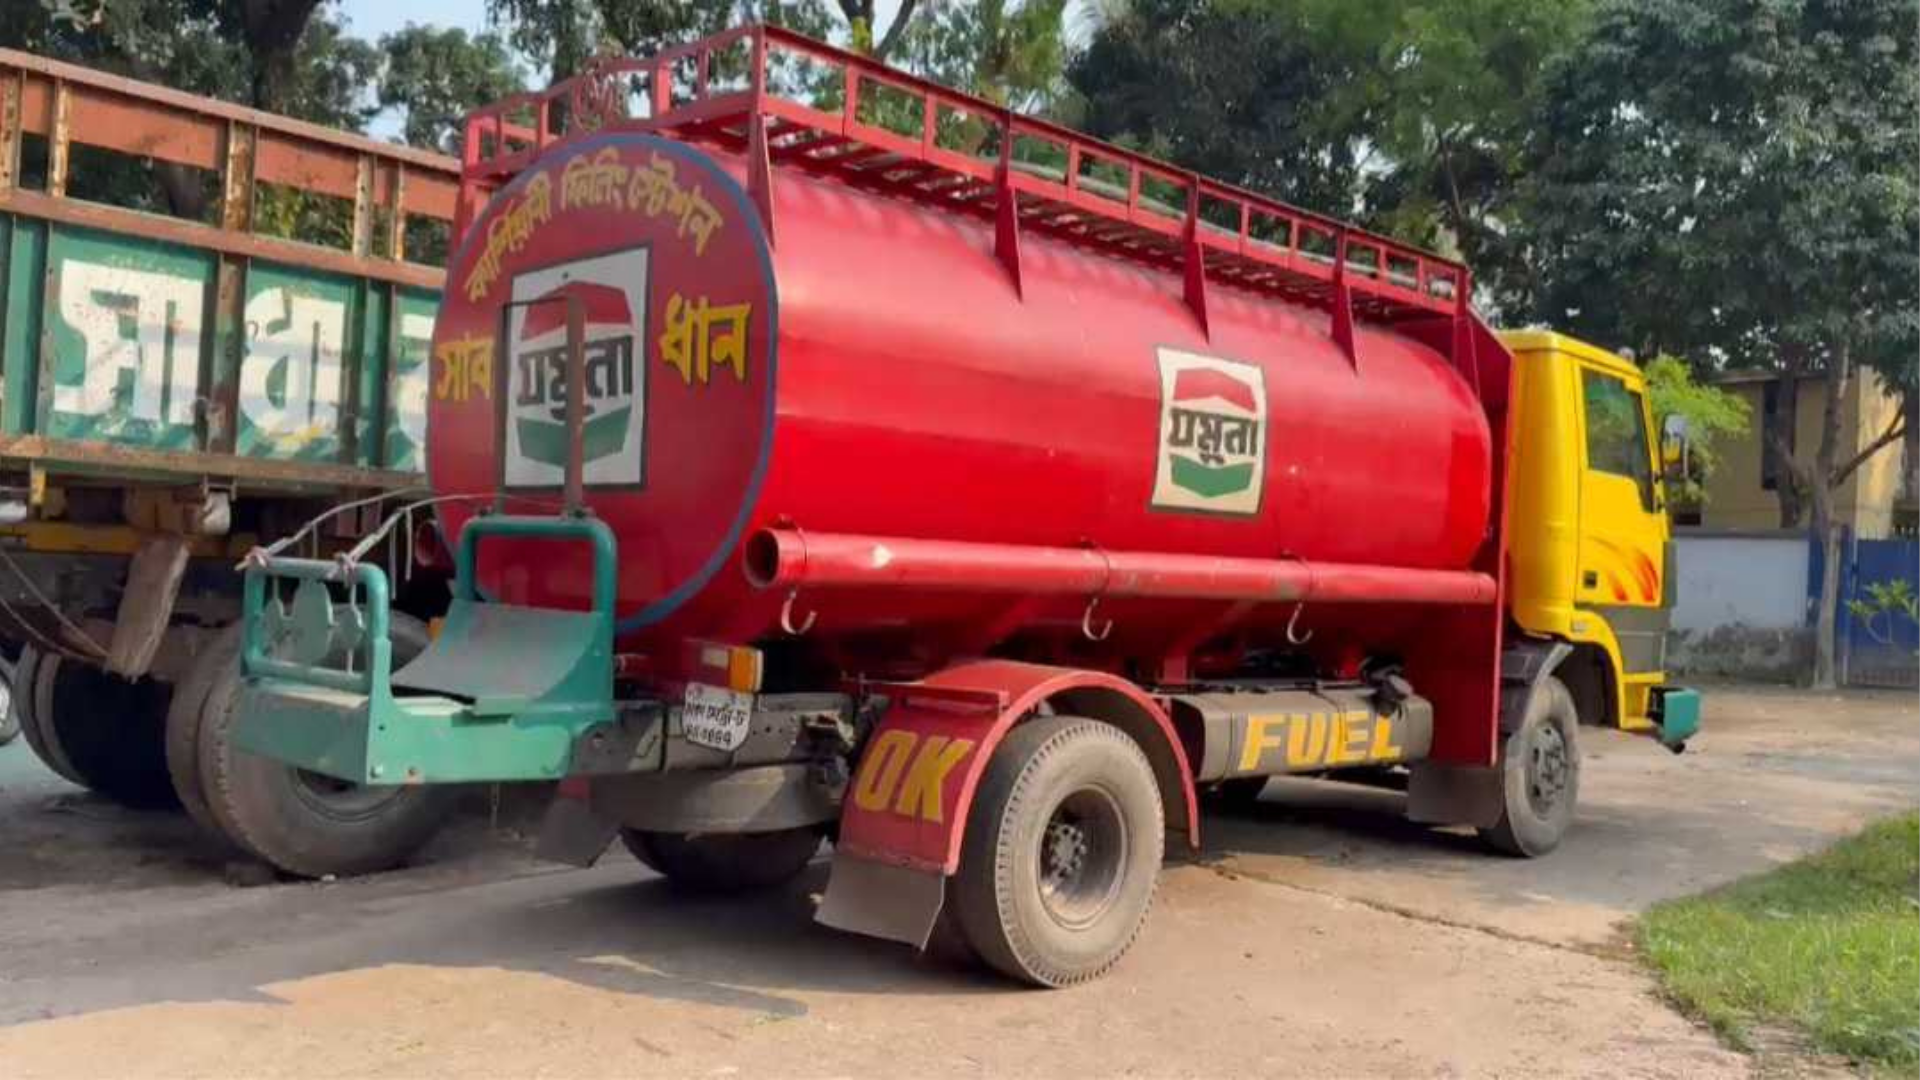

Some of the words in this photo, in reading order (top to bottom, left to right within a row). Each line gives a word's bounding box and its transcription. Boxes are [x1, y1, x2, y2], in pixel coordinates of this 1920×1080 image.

[560, 146, 623, 212] ফিলিং
[627, 150, 724, 258] স্টেশন
[658, 291, 752, 386] ধান
[853, 729, 974, 825] OK
[1237, 711, 1402, 771] FUEL
